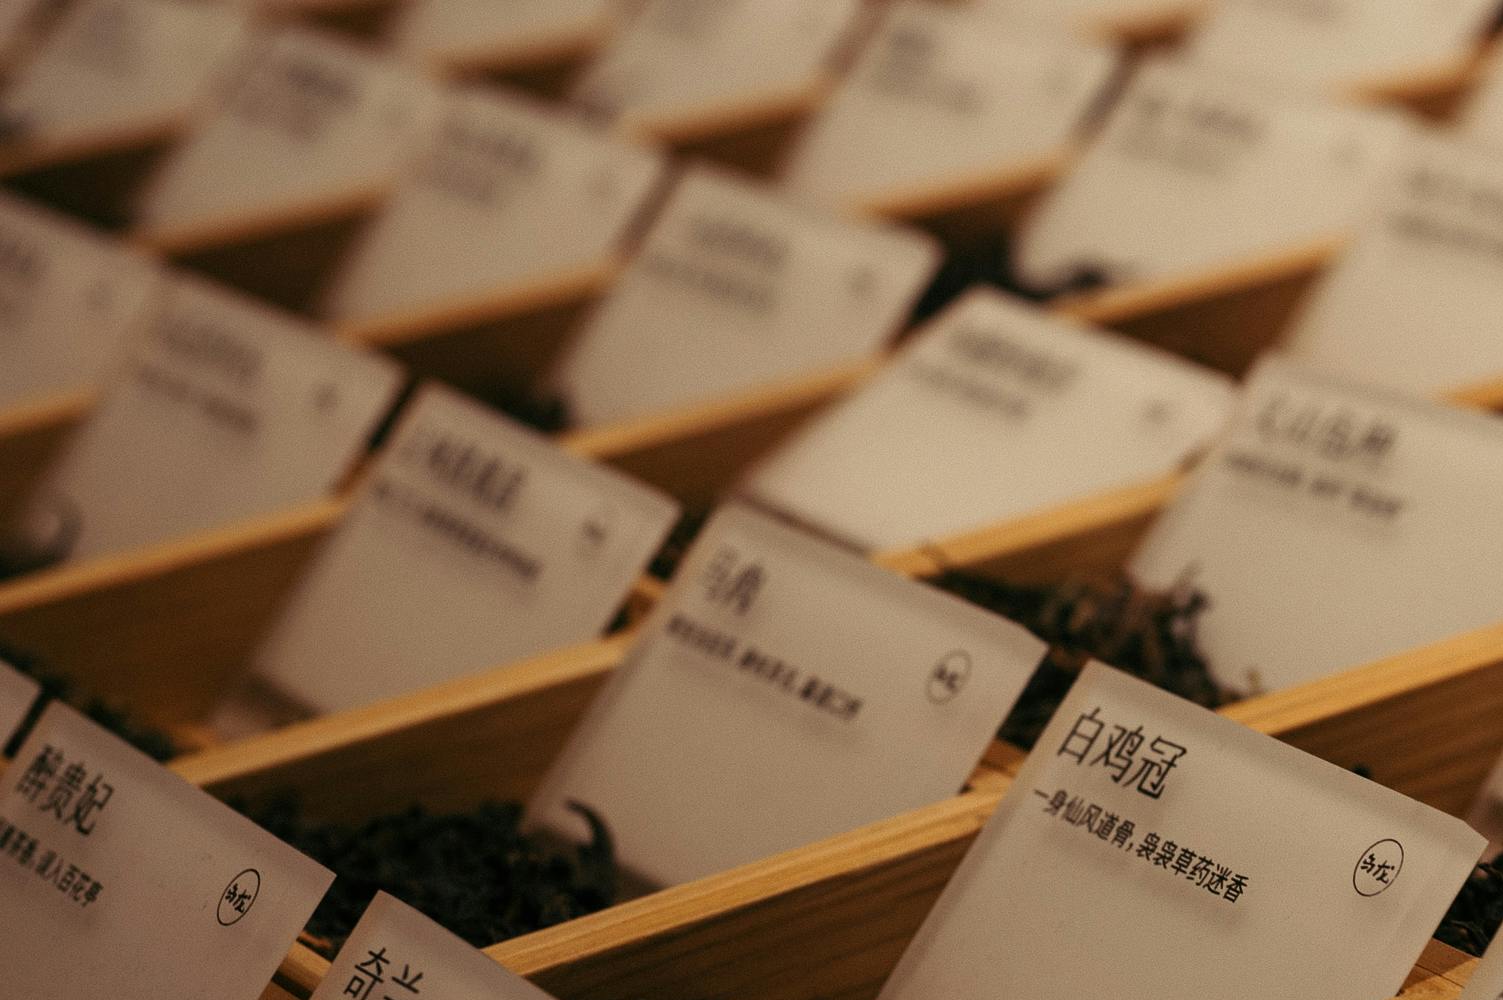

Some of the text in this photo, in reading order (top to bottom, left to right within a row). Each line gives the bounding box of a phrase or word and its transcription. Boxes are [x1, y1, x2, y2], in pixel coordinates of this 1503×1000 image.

[14, 744, 116, 836] 醉贵妃
[1057, 707, 1187, 800] 白鸡冠
[1033, 787, 1250, 904] 一身仙风道骨，袅袅草药迷香
